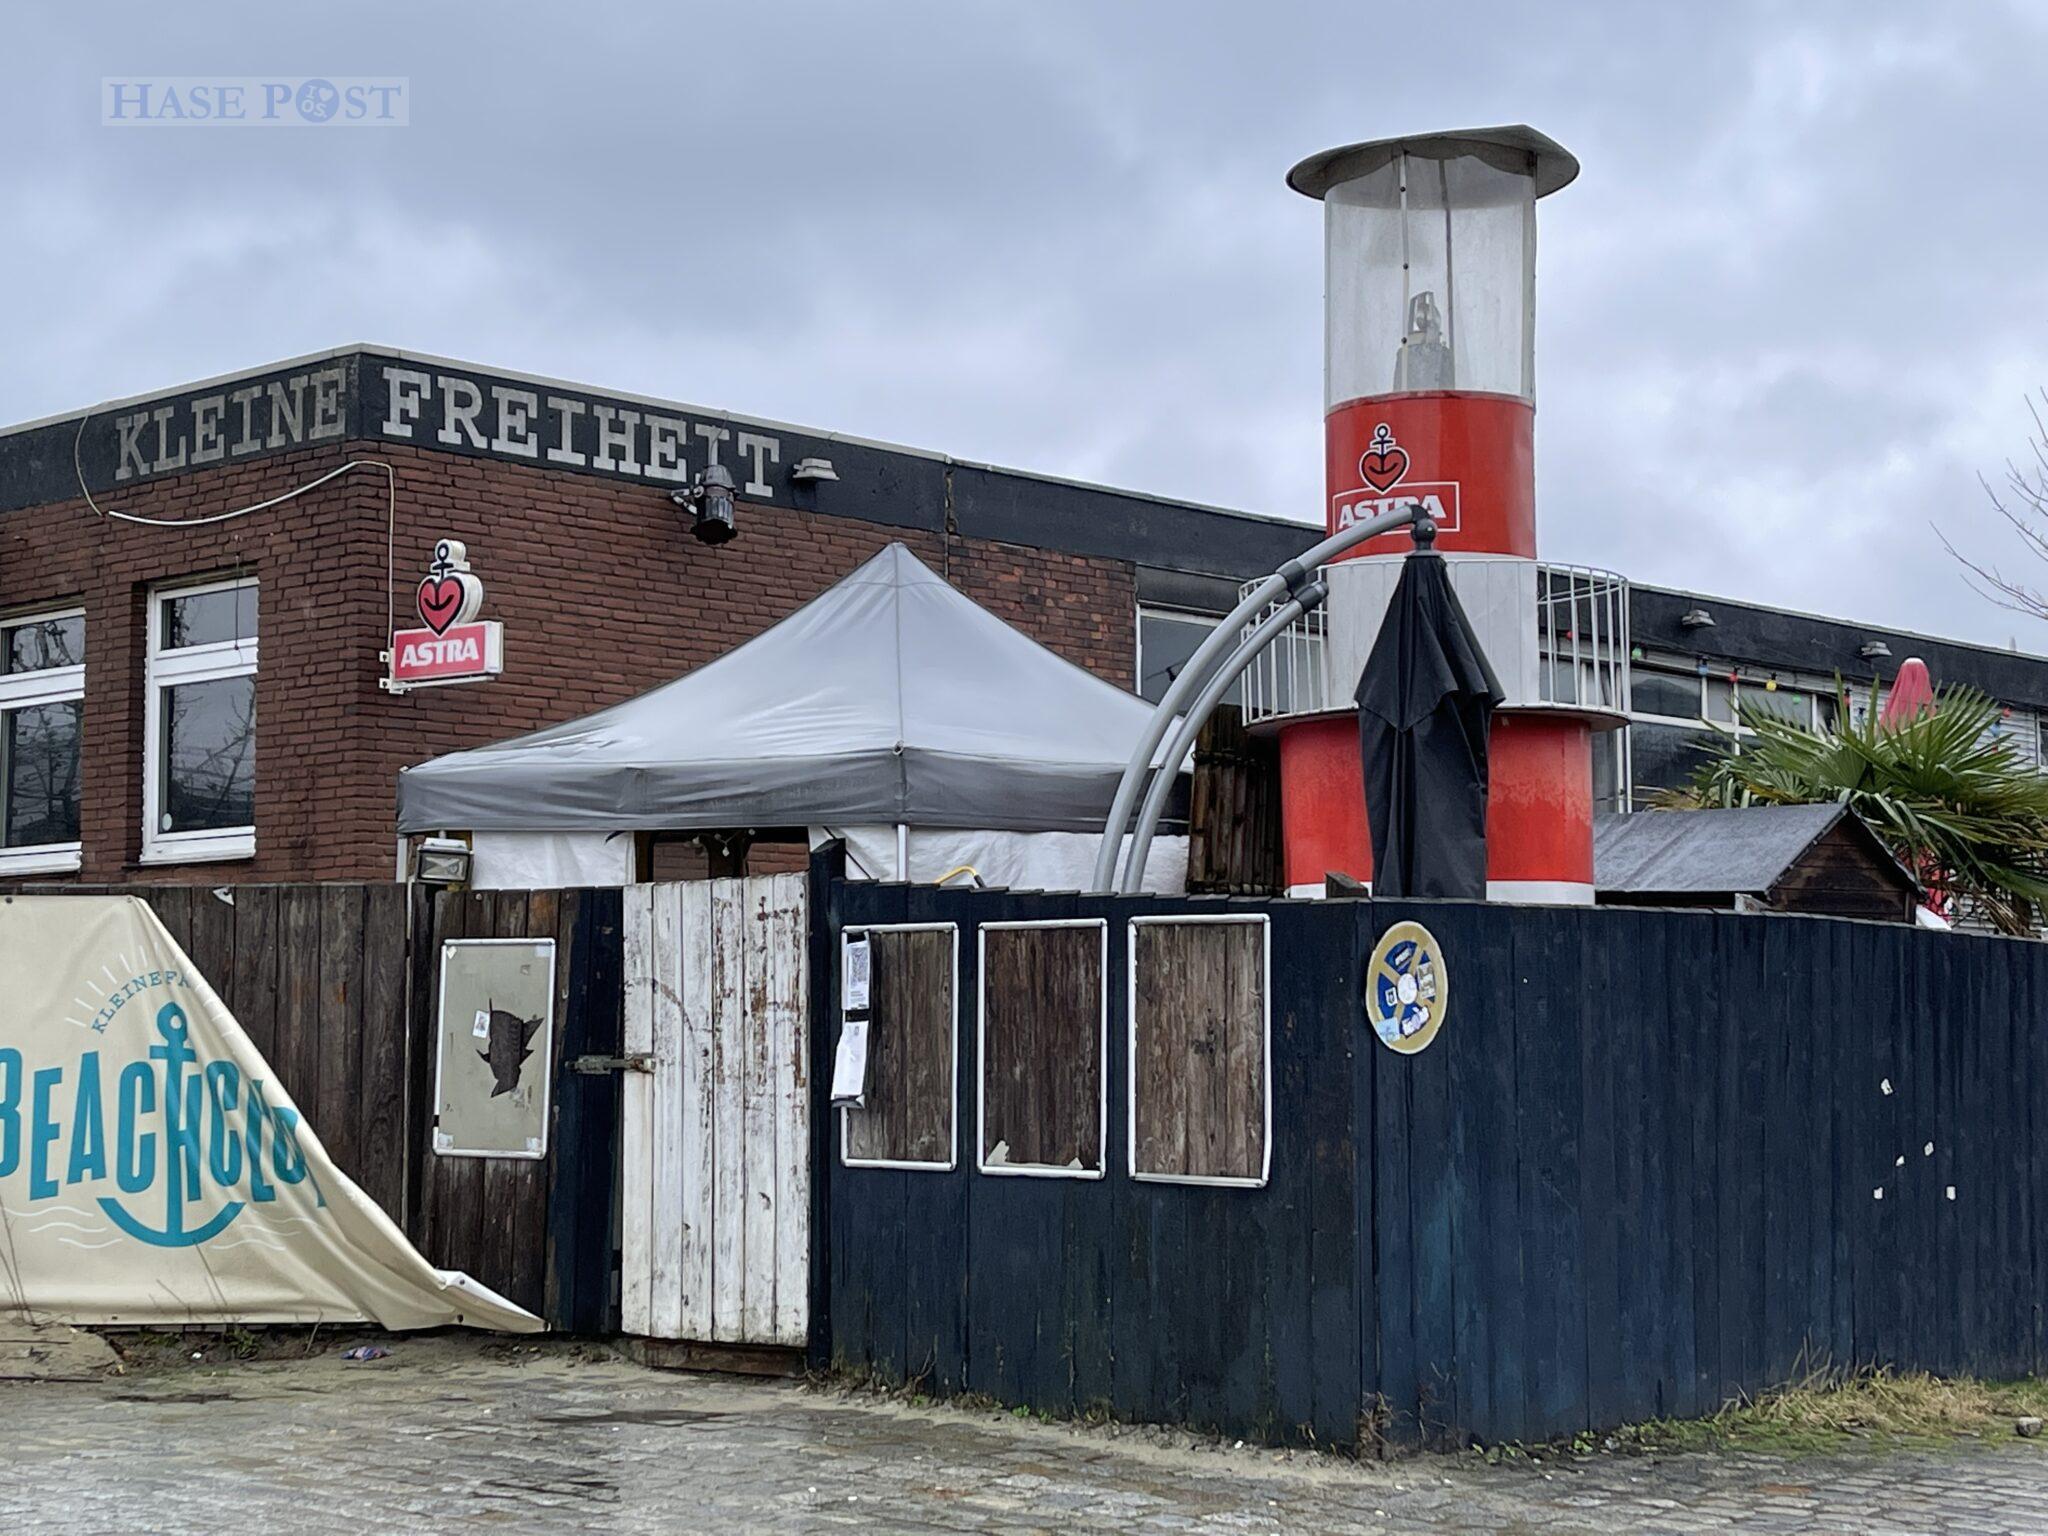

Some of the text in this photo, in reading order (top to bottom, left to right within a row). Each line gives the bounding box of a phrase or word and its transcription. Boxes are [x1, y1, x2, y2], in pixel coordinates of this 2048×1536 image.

[115, 366, 781, 498] KLEINE FREIHEIT
[400, 637, 480, 668] ASTRA
[0, 1048, 328, 1208] BEACHCLU
